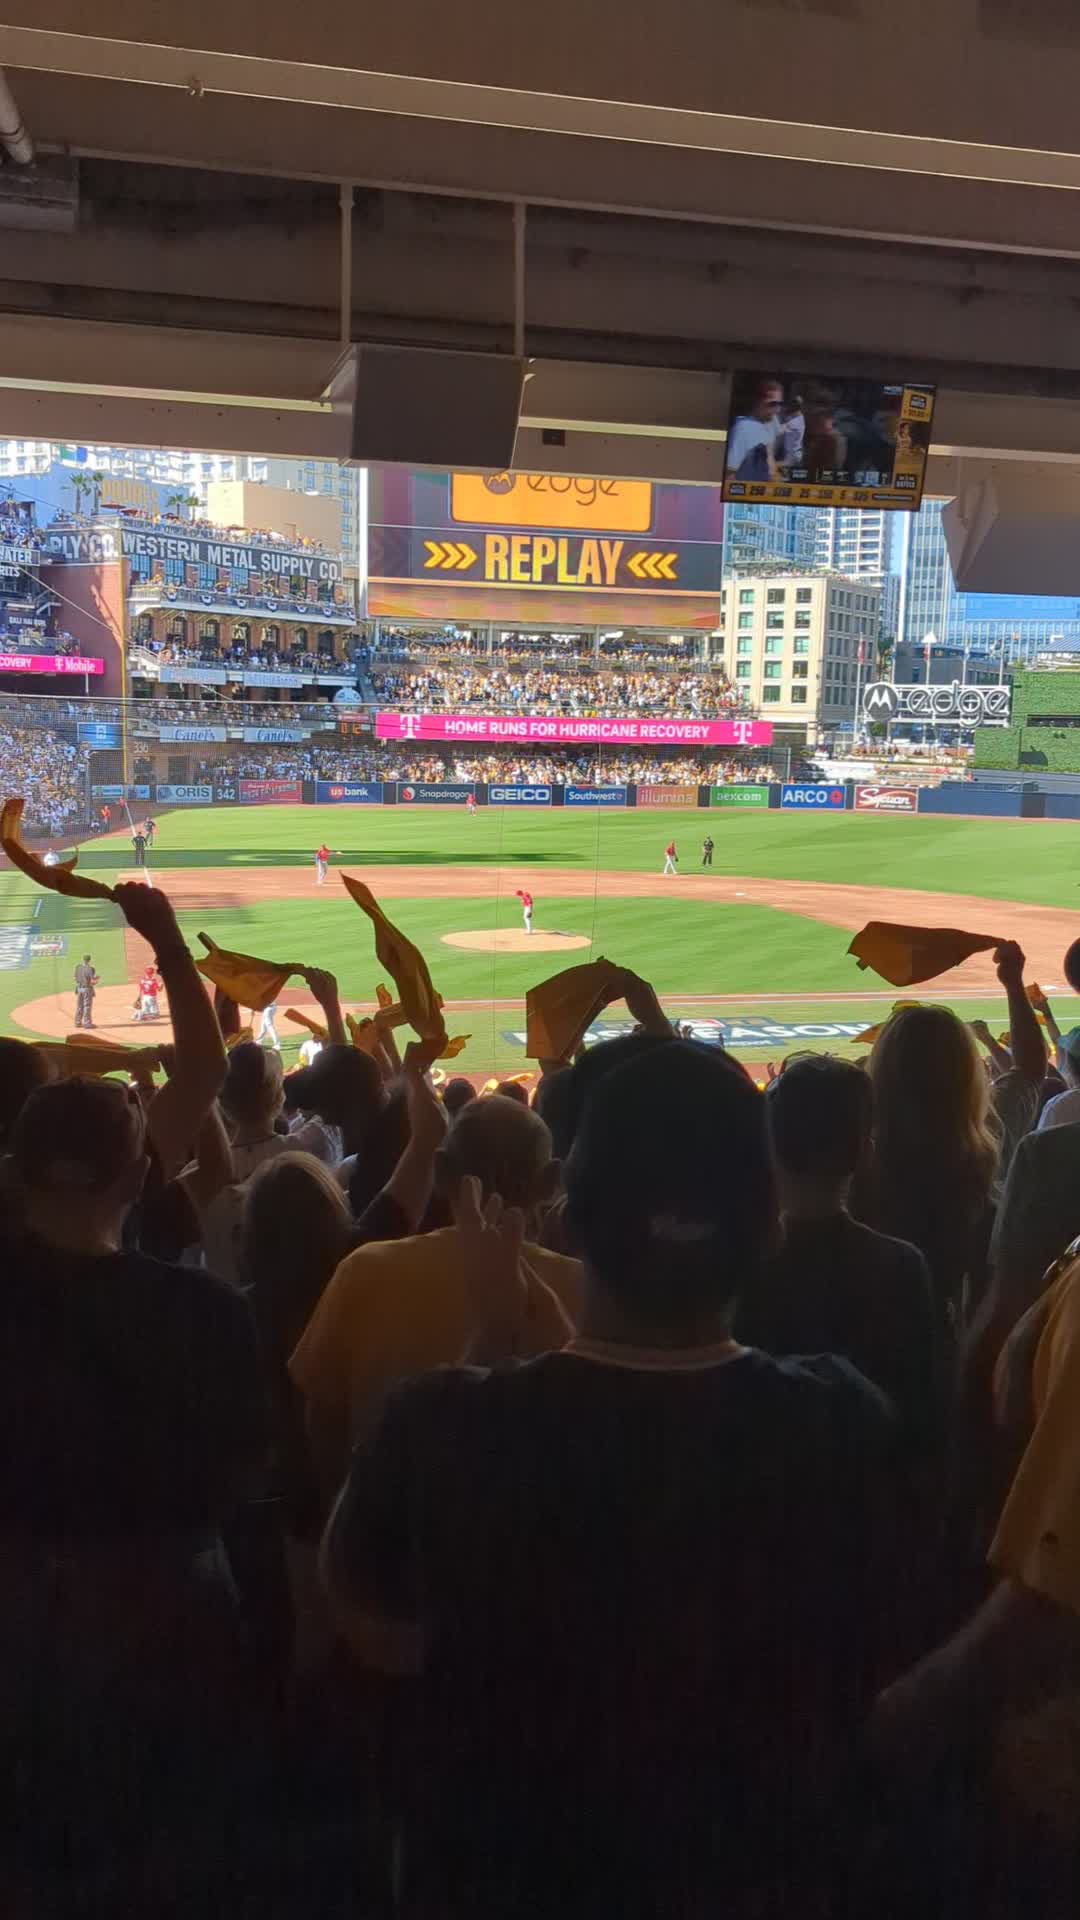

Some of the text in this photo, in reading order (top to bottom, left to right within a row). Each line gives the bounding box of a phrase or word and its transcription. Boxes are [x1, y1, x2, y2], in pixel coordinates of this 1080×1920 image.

[123, 532, 342, 582] WESTERN METAL SUPPLY CO.
[484, 533, 625, 585] REPLAY
[906, 680, 1010, 729] edge
[444, 720, 487, 734] HOME
[489, 721, 527, 736] RUNS
[529, 723, 557, 736] FOR
[559, 724, 638, 738] HURRICANE
[639, 726, 710, 739] RECOVERY
[175, 786, 210, 798] ORIS
[216, 788, 235, 801] 342
[344, 785, 369, 797] bank
[419, 789, 470, 800] Snapdragon
[490, 788, 550, 801] GEICO
[568, 791, 616, 801] Southwest
[640, 789, 693, 804] illumina
[783, 790, 828, 804] ARCO
